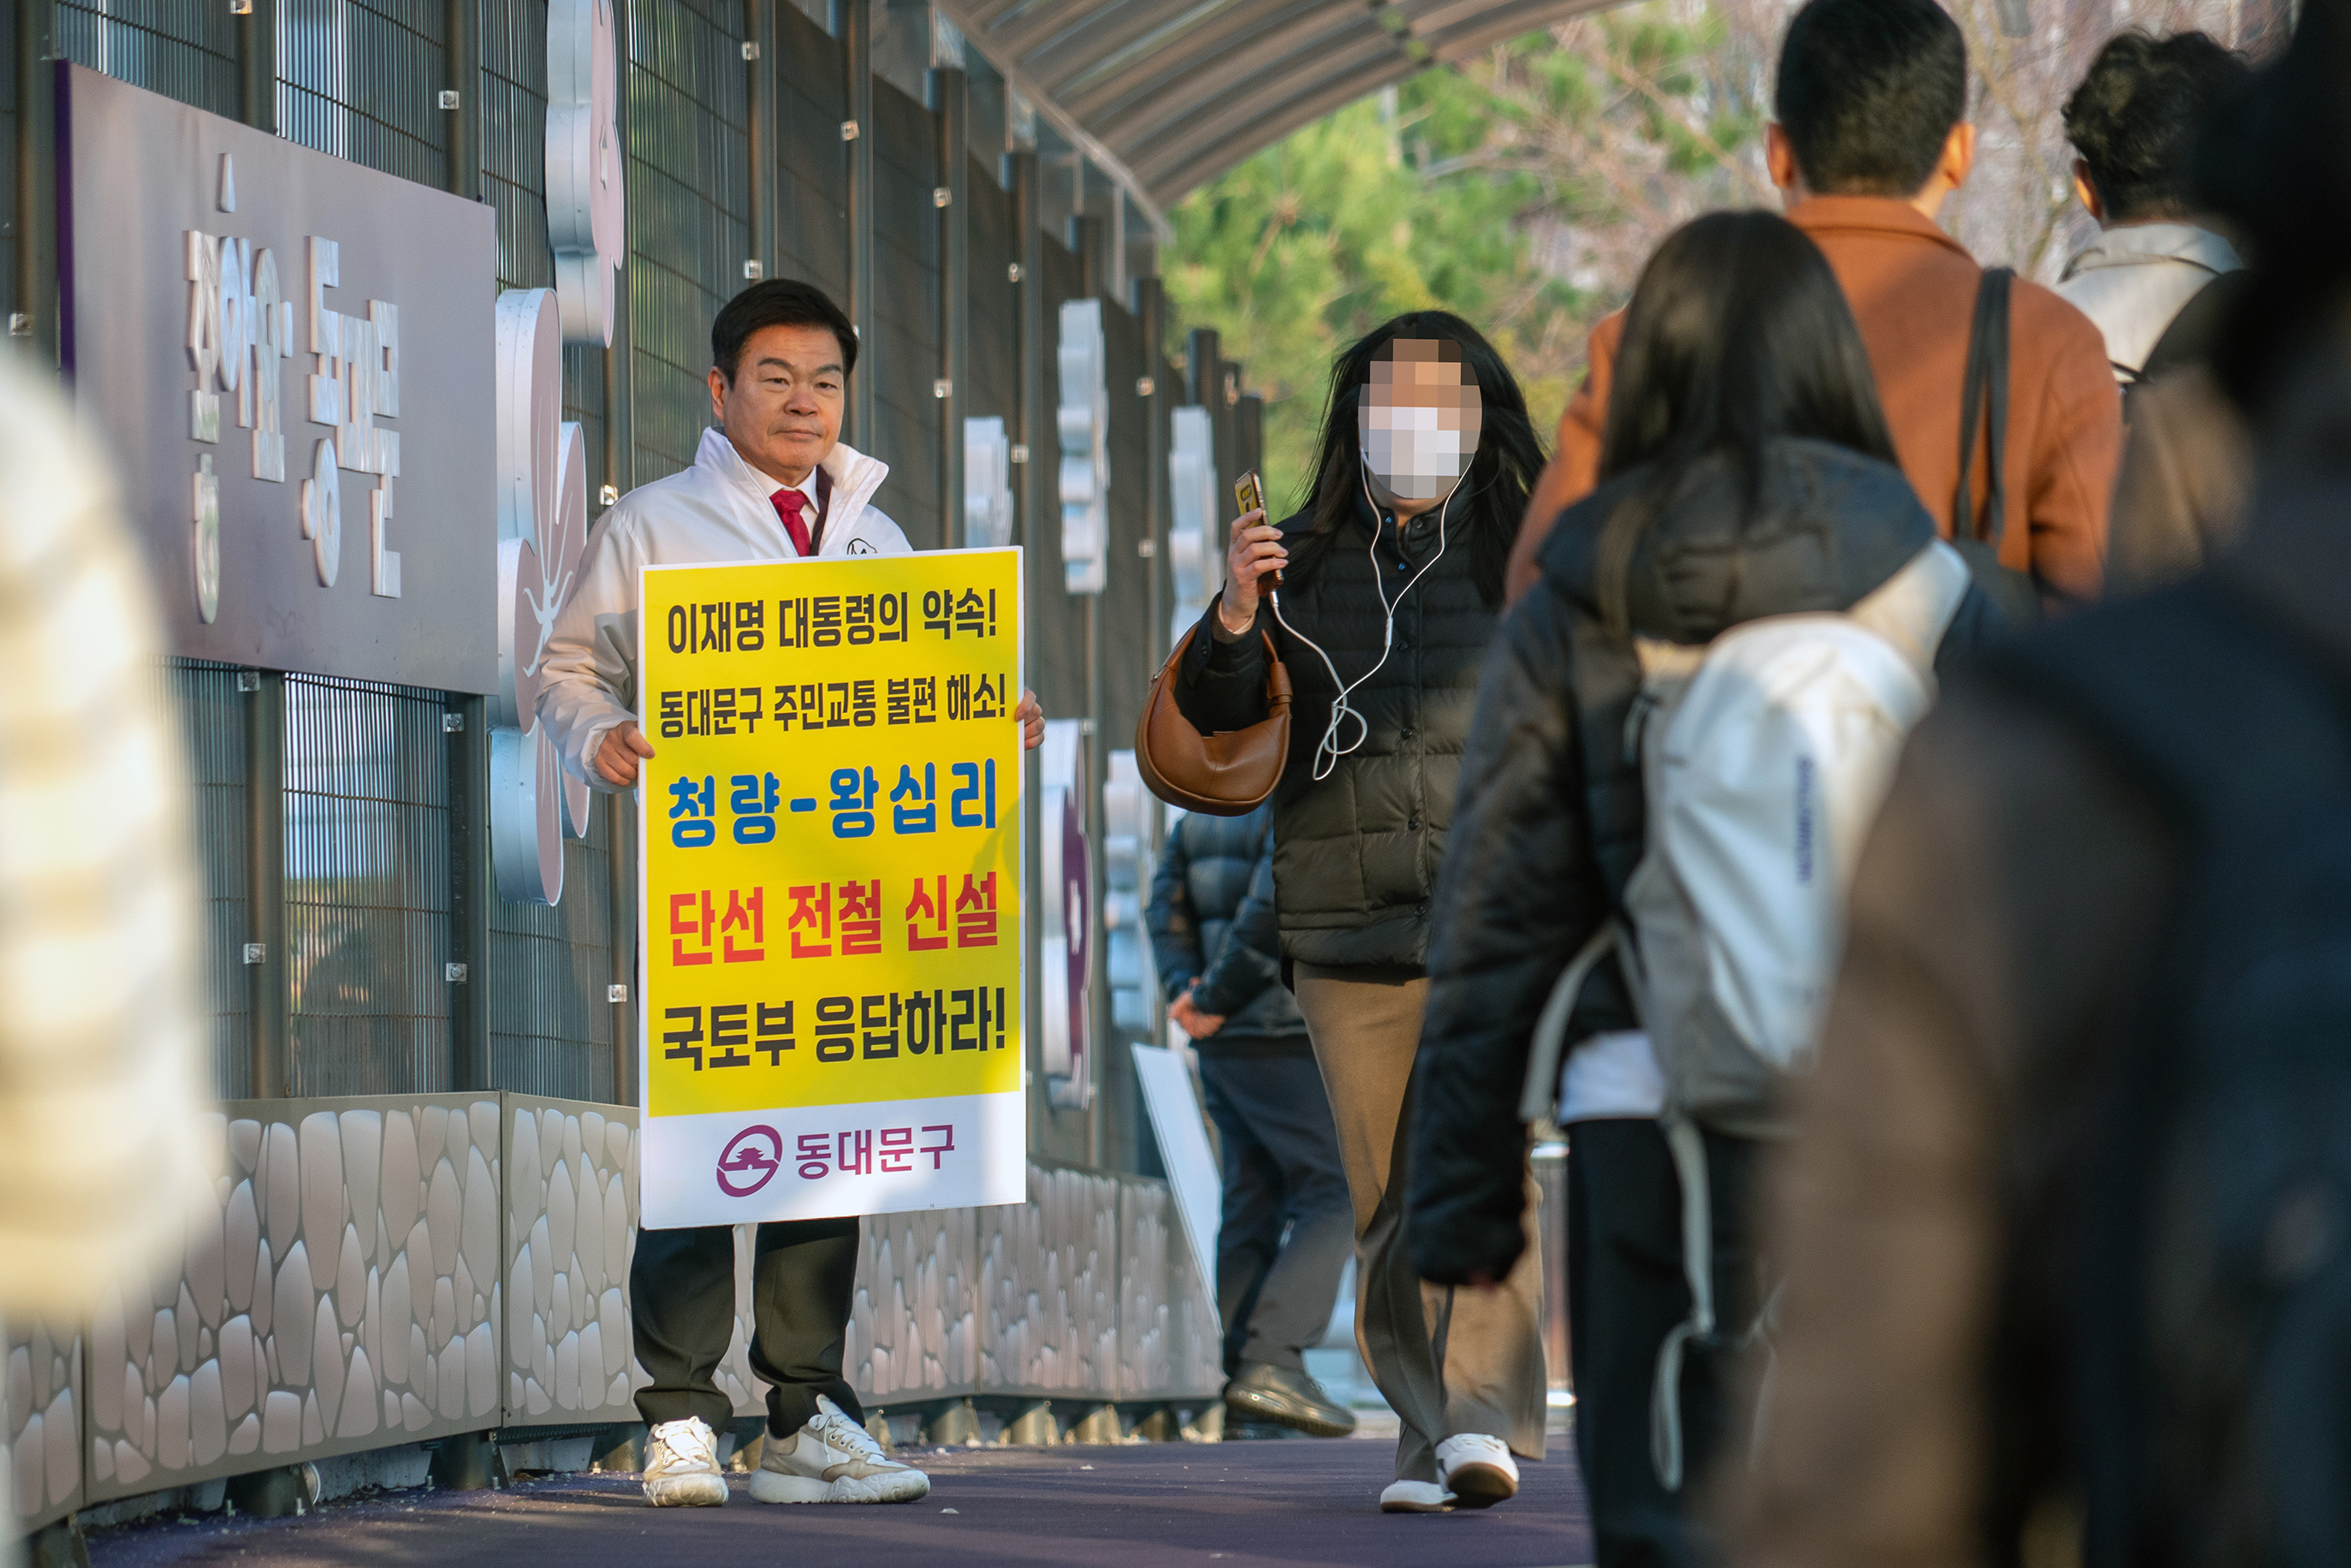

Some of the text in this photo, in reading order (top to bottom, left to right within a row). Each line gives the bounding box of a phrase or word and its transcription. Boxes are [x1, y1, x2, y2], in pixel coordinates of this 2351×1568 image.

[668, 587, 996, 654] 이재명 대통령의 약속!
[660, 673, 1006, 739] 동대문구 주민교통 불편 해소!
[669, 871, 998, 967] 단선 전철 신설
[662, 985, 1005, 1072] 국토부 응답하라!
[795, 1124, 955, 1179] 동대문구
